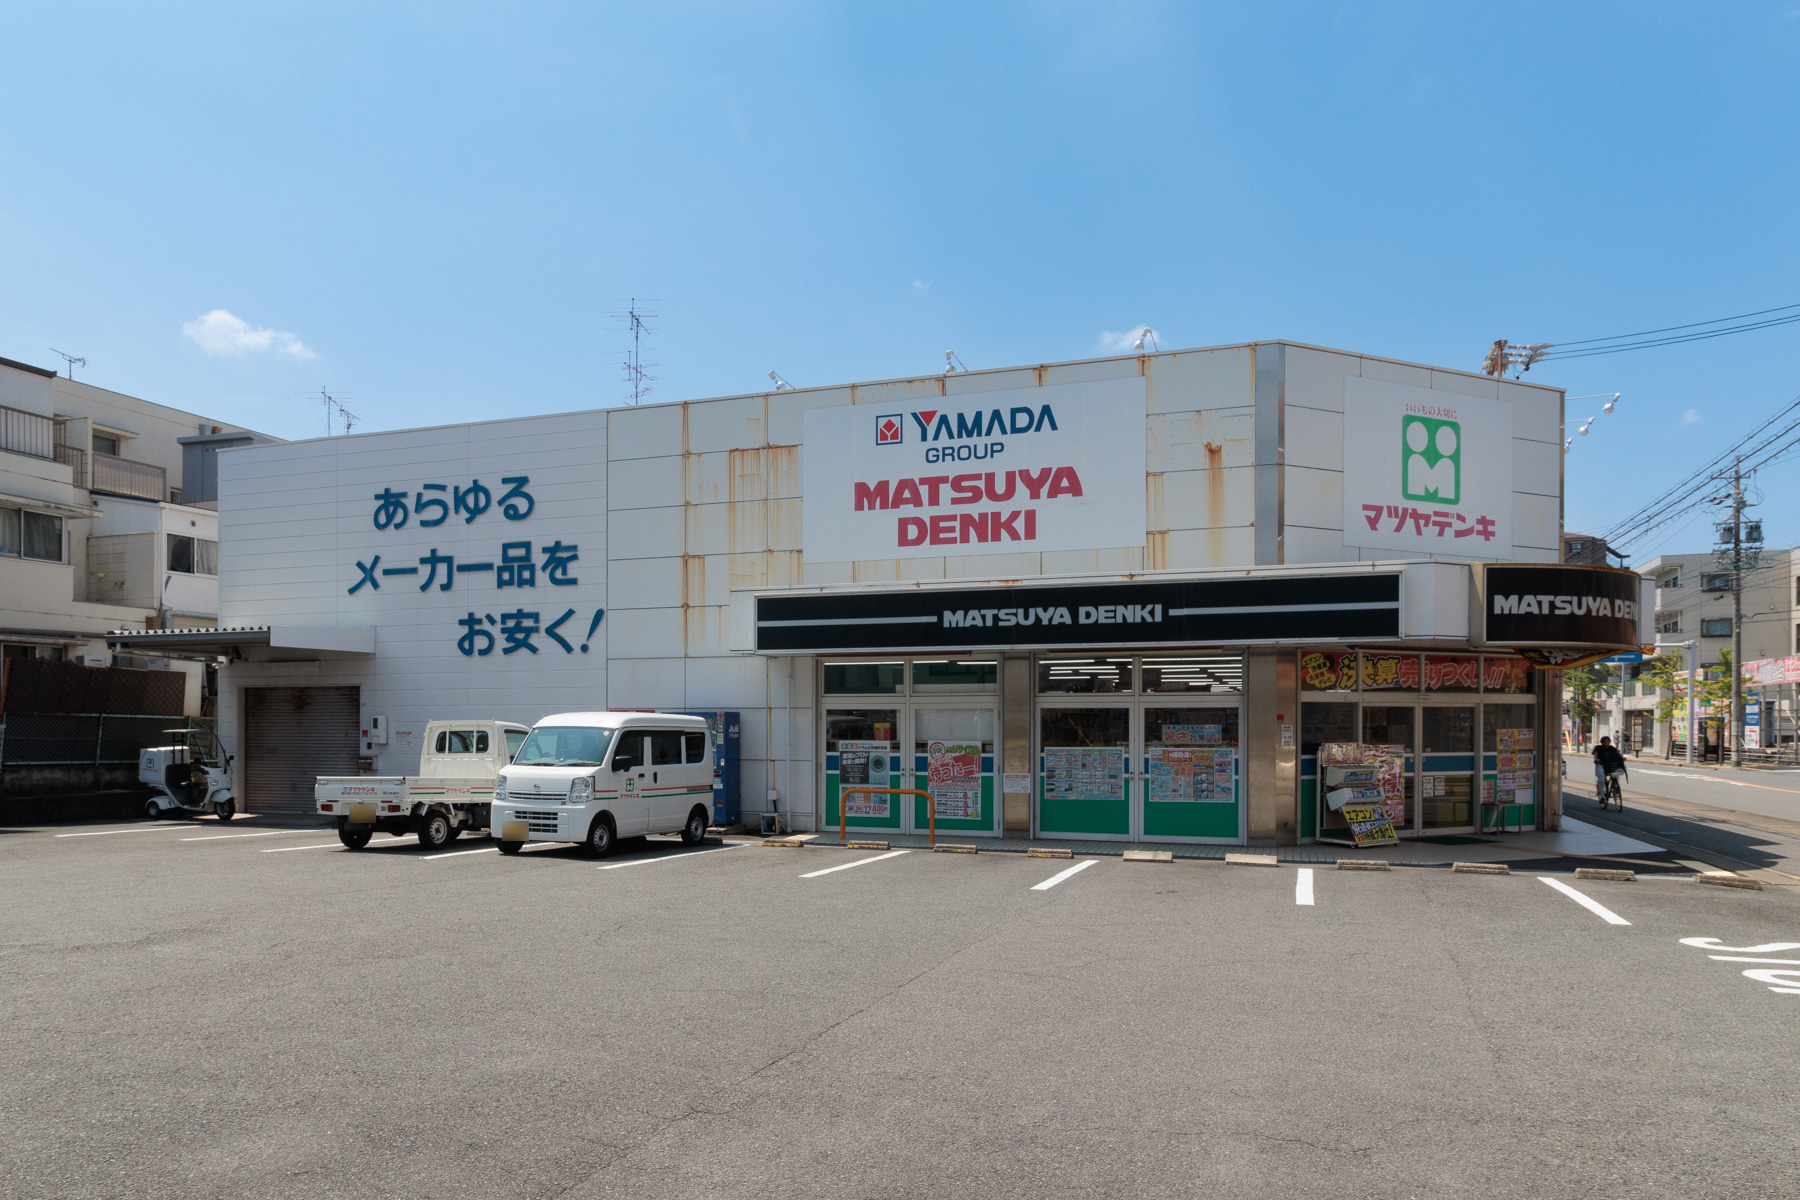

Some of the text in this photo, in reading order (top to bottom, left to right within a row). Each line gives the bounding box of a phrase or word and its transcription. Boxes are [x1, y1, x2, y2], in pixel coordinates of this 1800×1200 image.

[911, 404, 1058, 442] YAMADA
[1405, 403, 1458, 420] いいもの大切に
[925, 442, 1005, 464] GROUP
[373, 475, 535, 531] あらゆる
[854, 466, 1083, 511] MATSUYA
[897, 509, 1037, 547] DENKI
[1362, 503, 1496, 542] マツヤデンキ
[347, 540, 579, 595] メーカー品を
[943, 603, 1163, 628] MATSUYA DENKI
[1493, 594, 1612, 617] MATSUYA
[457, 608, 605, 656] お安く!
[1346, 808, 1372, 820] エアコン
